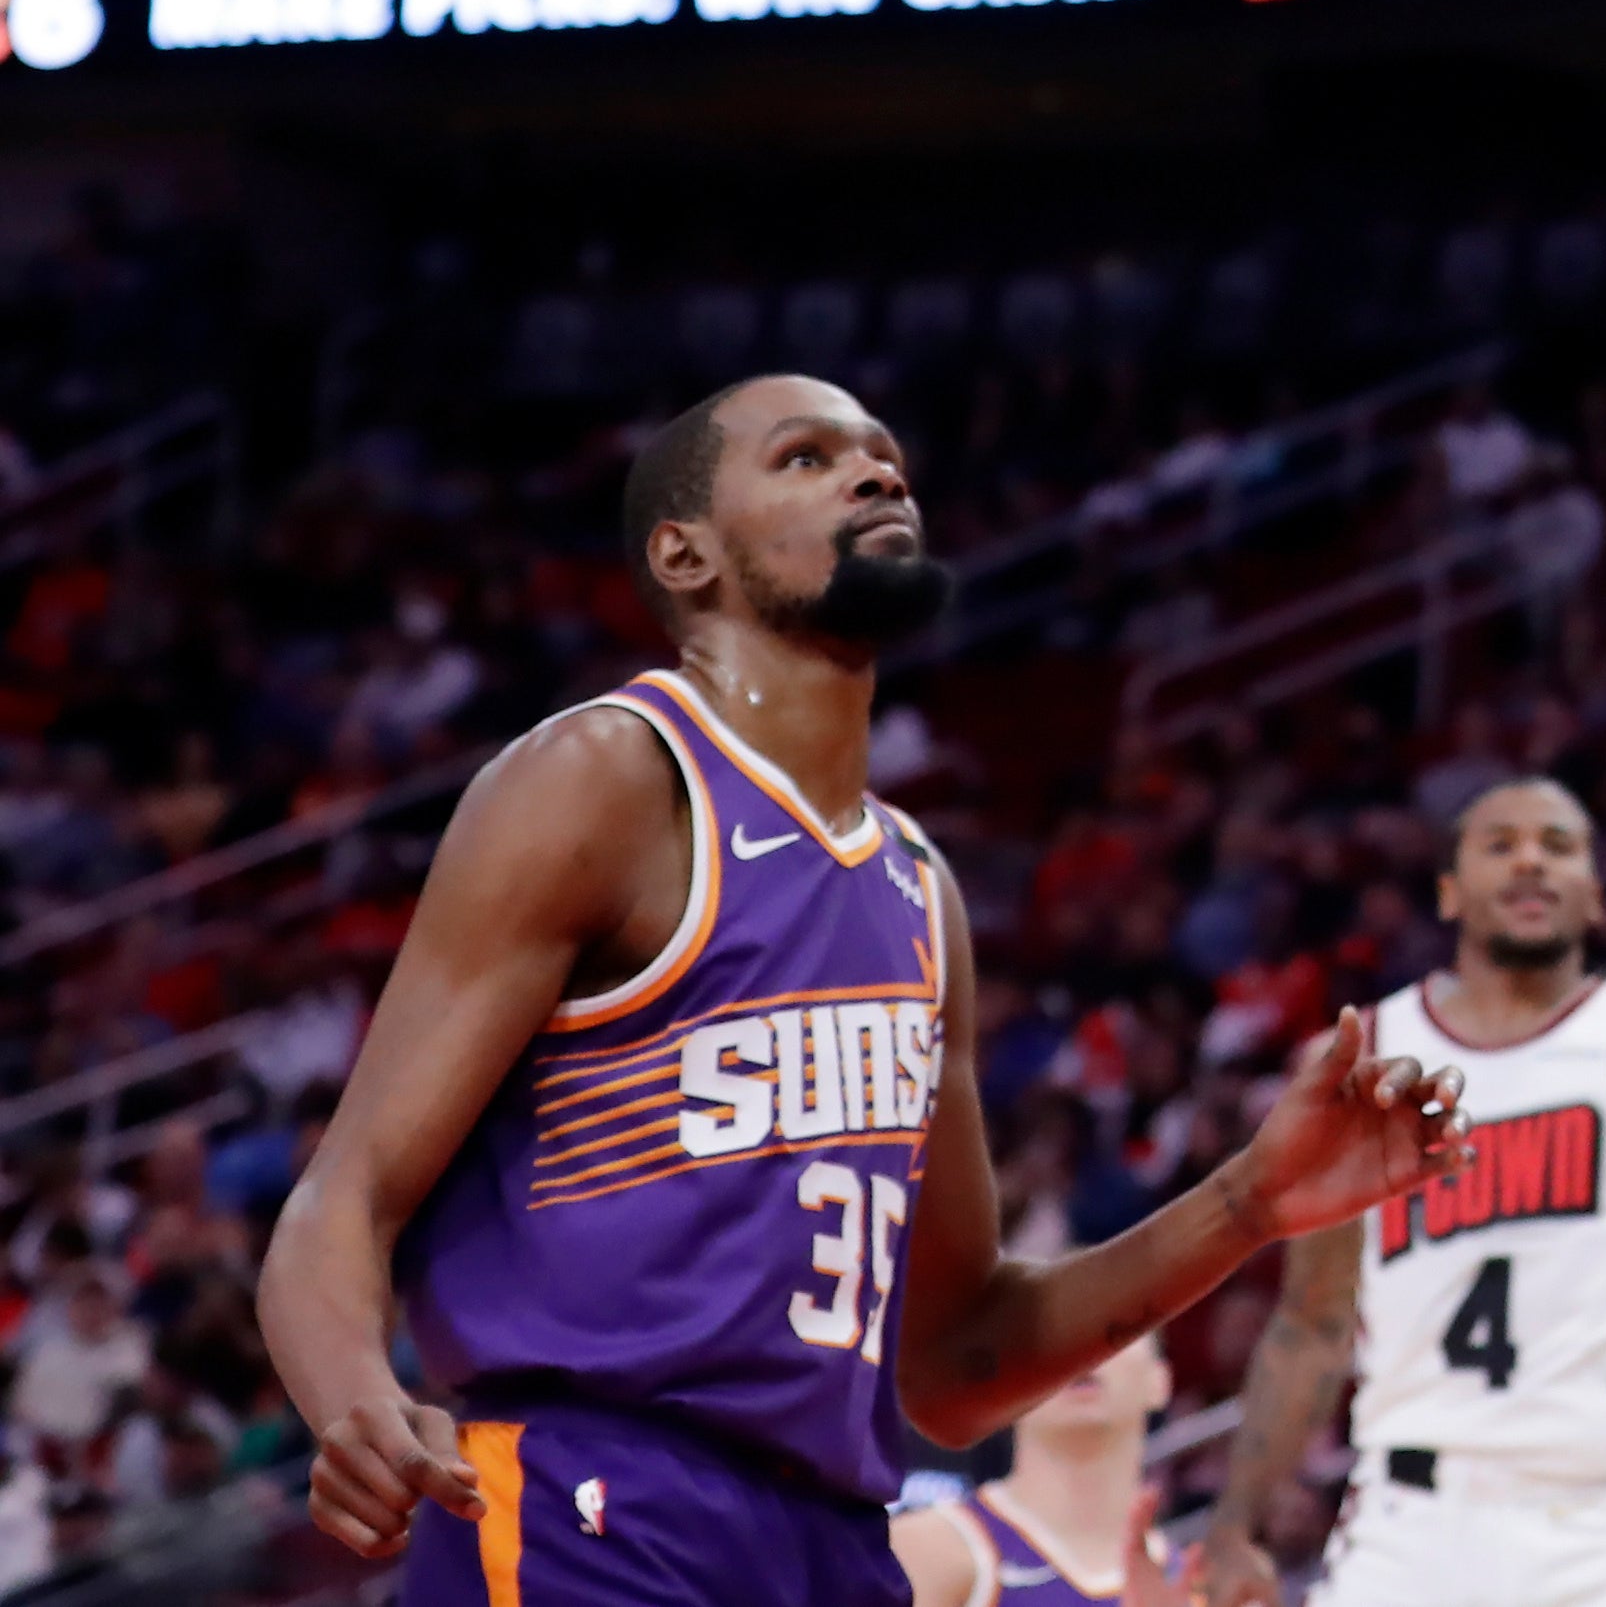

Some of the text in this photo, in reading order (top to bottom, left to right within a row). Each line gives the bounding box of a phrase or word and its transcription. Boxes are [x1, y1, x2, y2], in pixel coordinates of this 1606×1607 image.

[678, 1002, 931, 1158] SUNS
[787, 1160, 907, 1366] 35
[1442, 1256, 1518, 1392] 4
